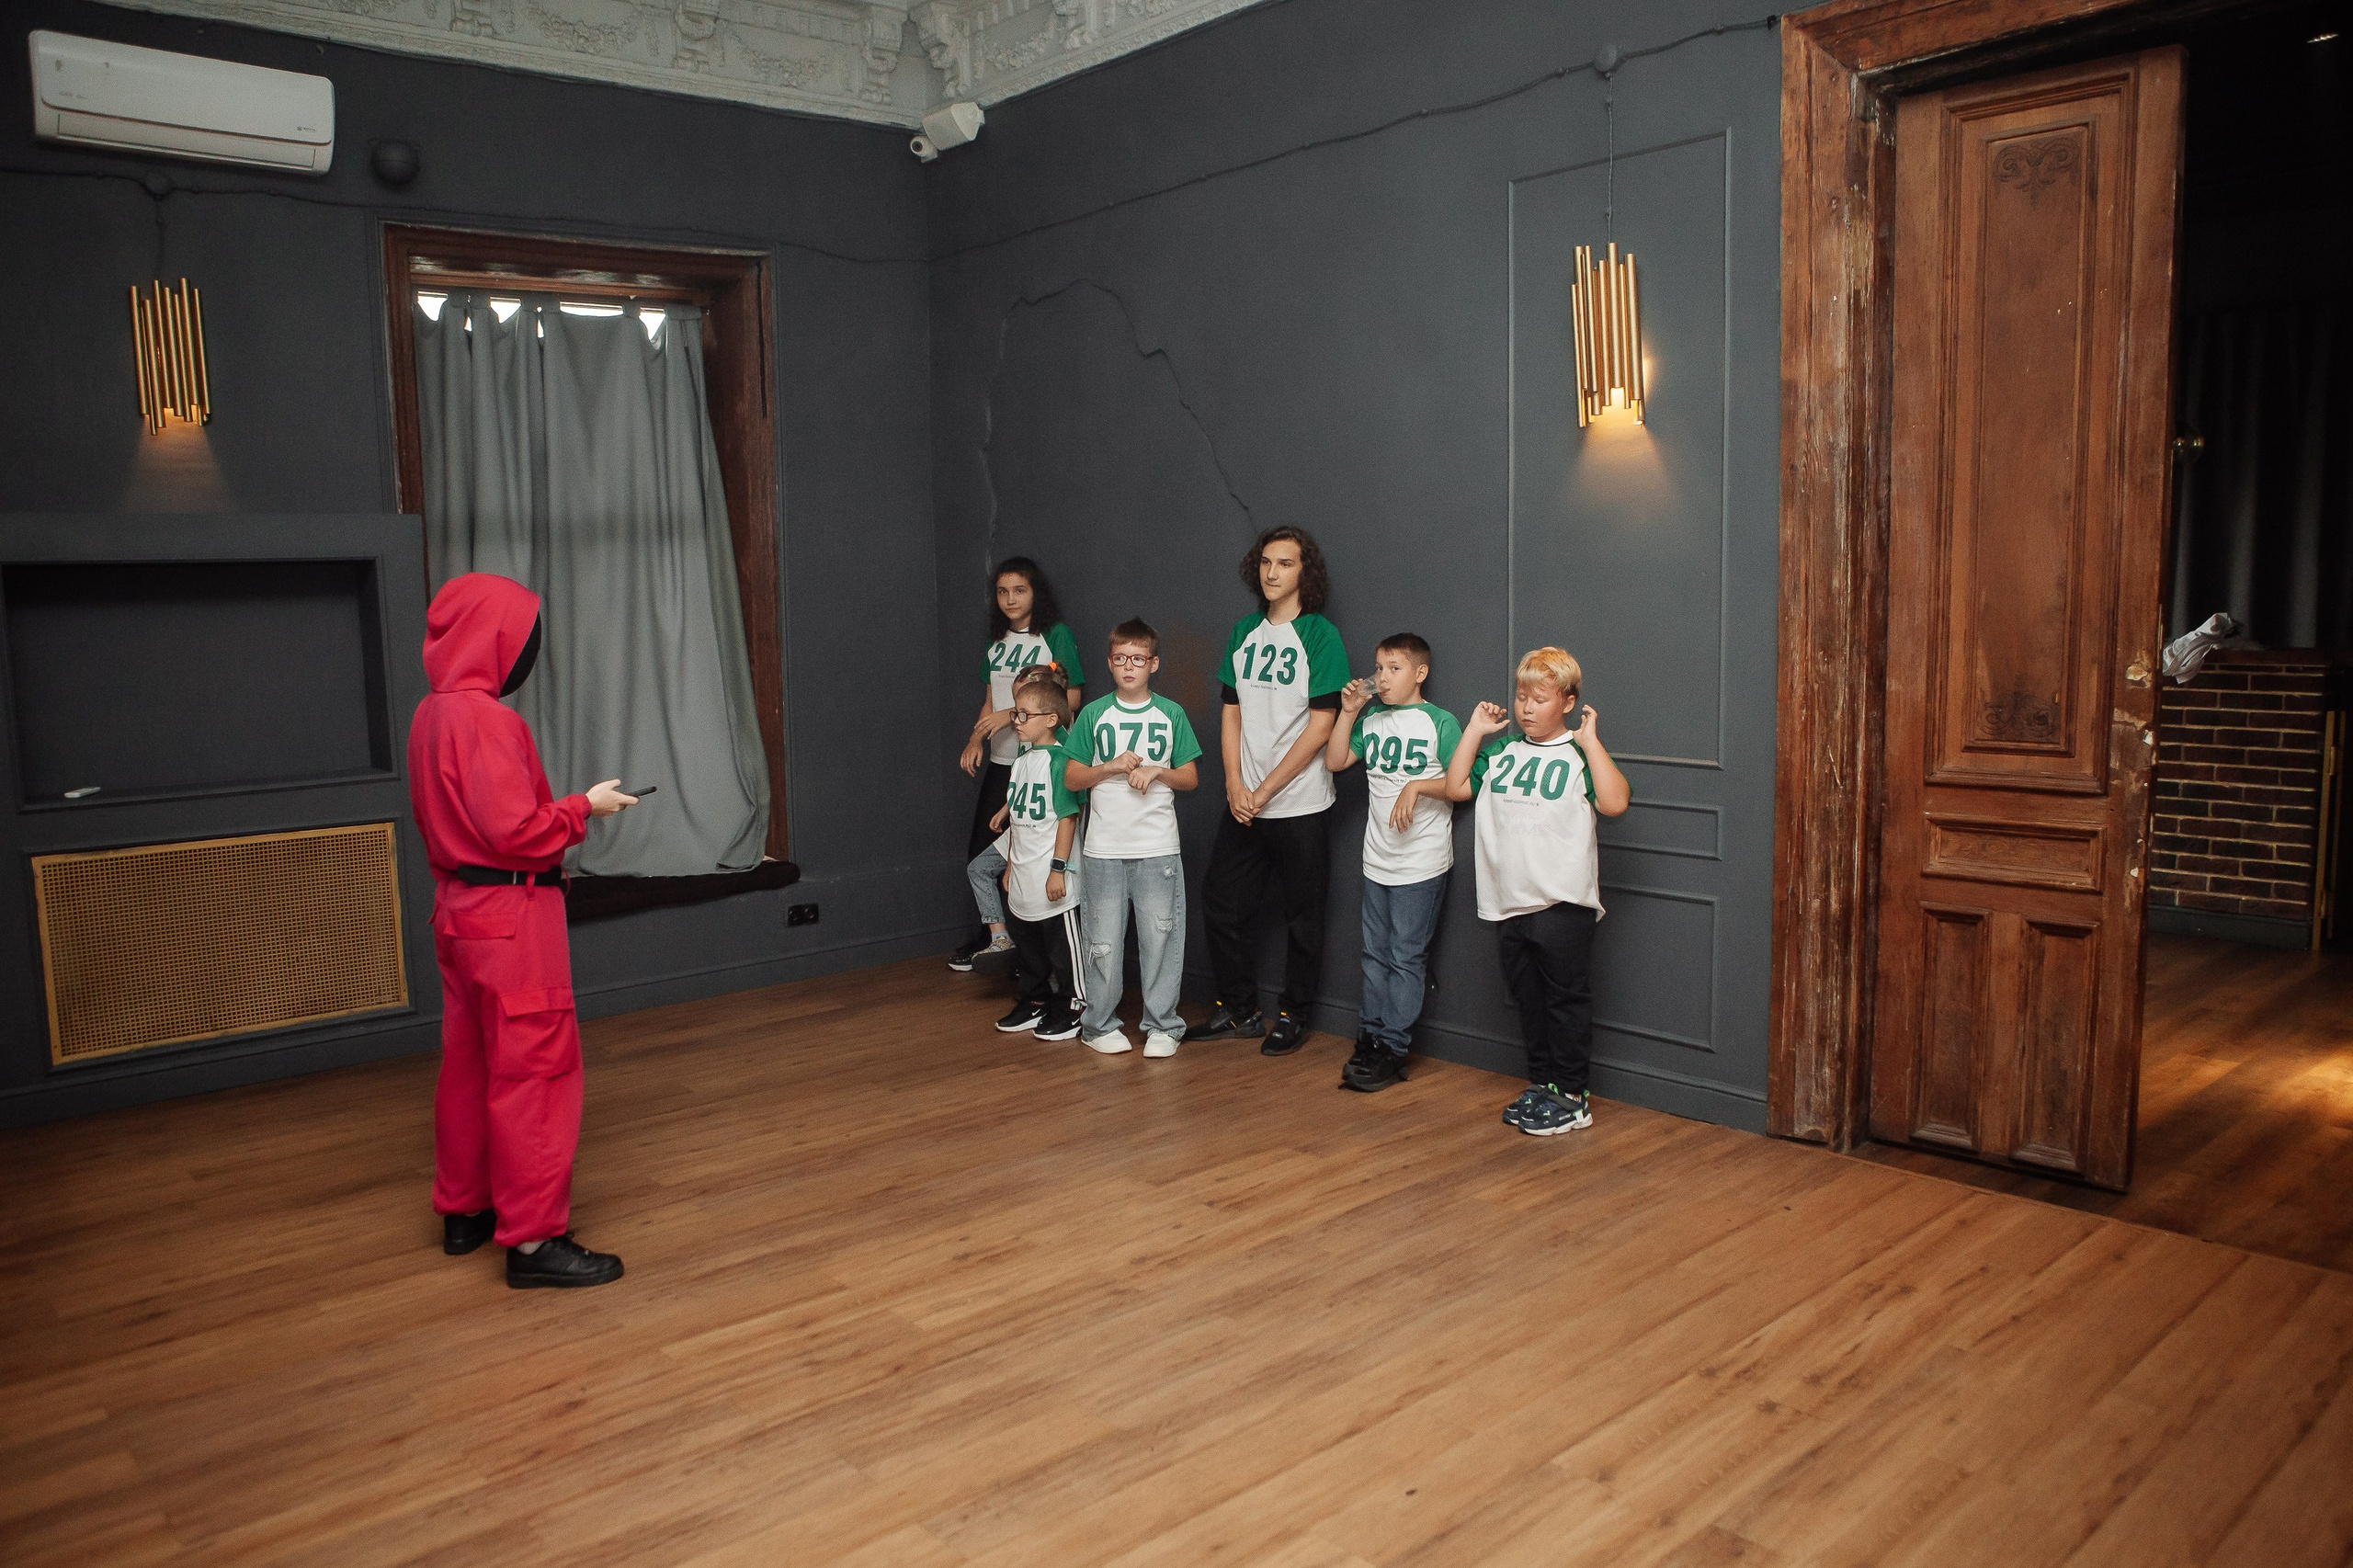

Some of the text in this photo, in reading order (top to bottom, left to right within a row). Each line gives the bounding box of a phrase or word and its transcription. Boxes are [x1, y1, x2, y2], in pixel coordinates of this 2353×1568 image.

[990, 642, 1041, 673] 244
[1242, 642, 1298, 685] 123
[1096, 722, 1167, 762] 075
[1363, 733, 1428, 775] 095
[1491, 755, 1570, 801] 240
